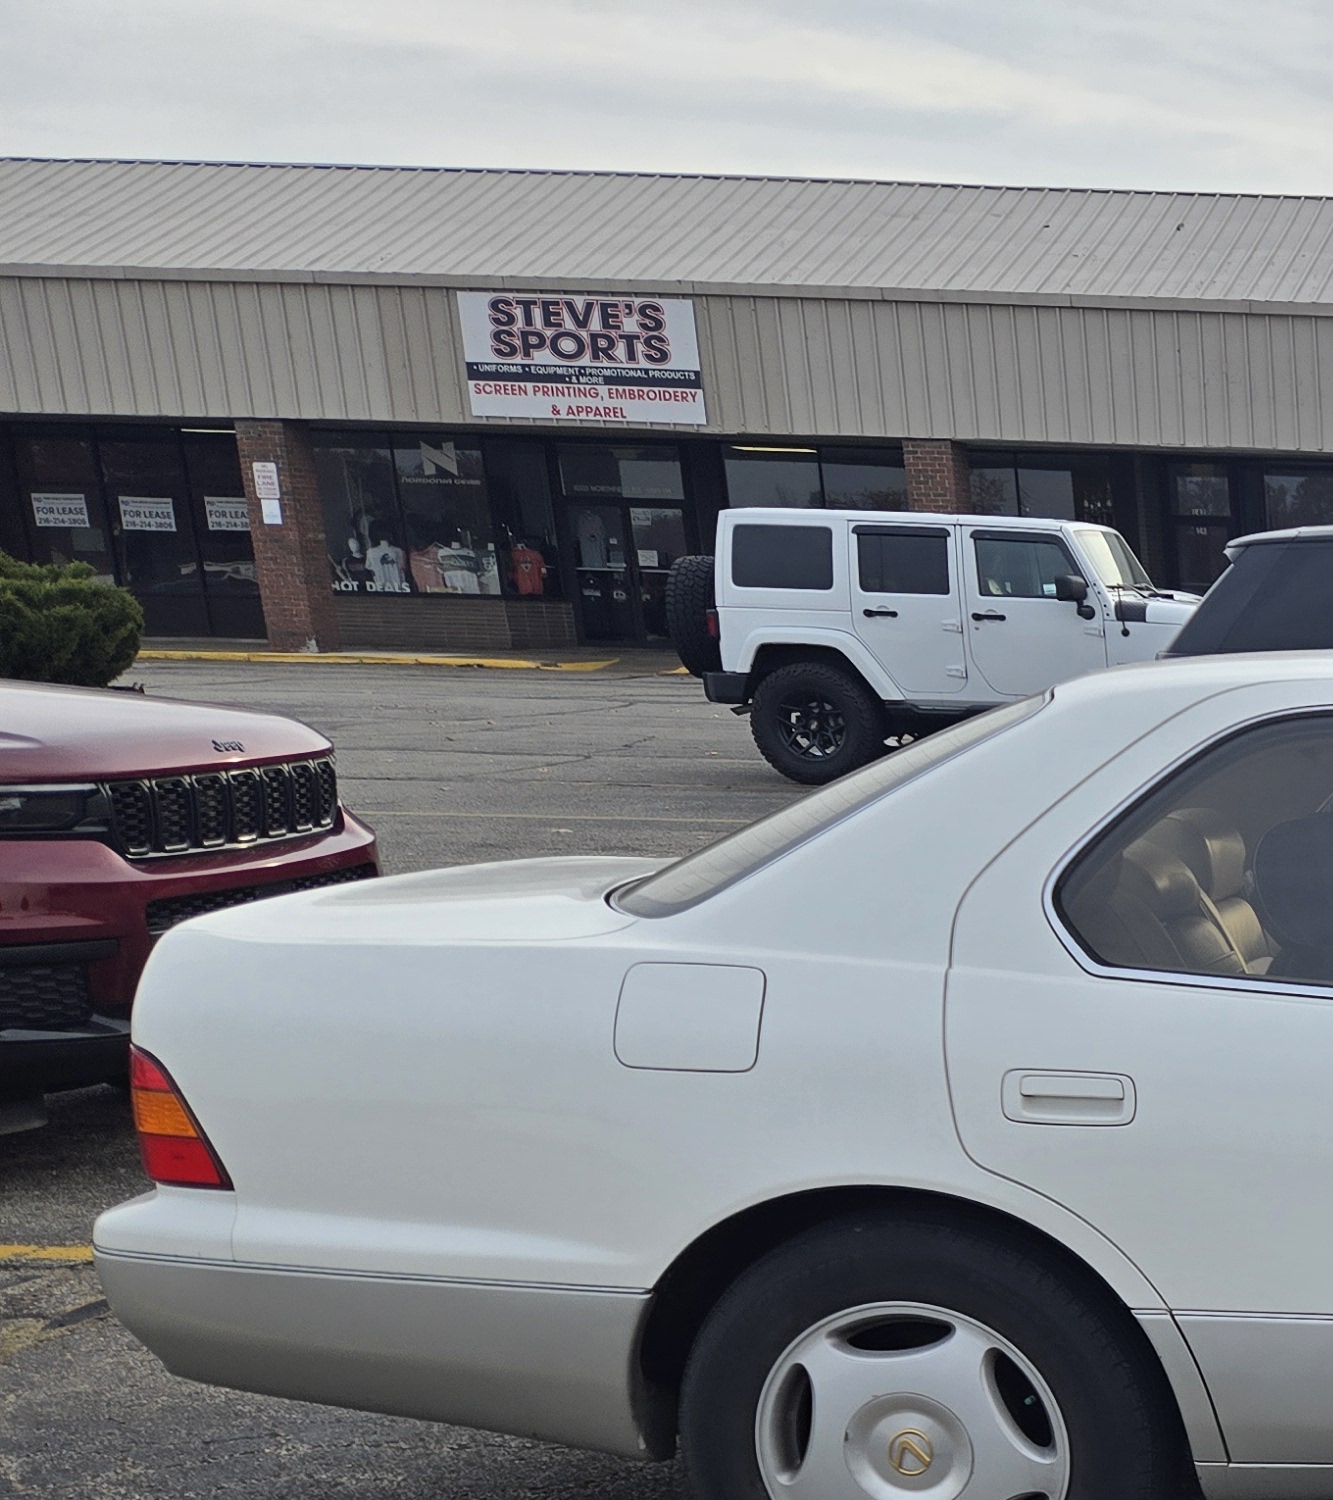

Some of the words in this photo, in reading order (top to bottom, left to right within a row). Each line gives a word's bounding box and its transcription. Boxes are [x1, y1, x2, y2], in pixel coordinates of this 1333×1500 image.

[488, 296, 666, 333] STEVE'S
[489, 328, 671, 366] SPORTS
[478, 364, 523, 374] UNIFORMS
[530, 365, 579, 376] EQUIPMENT
[585, 367, 648, 379] PROMOTIONAL
[648, 370, 696, 380] PRODUCTS
[579, 376, 605, 385] MORE
[474, 383, 529, 397] SCREEN
[532, 384, 604, 401] PRINTING,
[608, 386, 698, 403] EMBROIDERY
[551, 404, 562, 416] &
[566, 405, 627, 419] APPAREL
[36, 506, 55, 515] FOR
[56, 507, 85, 516] LEASE
[123, 509, 142, 518] FOR
[143, 510, 172, 519] LEASE
[209, 510, 228, 518] FOR
[228, 510, 249, 519] LEA
[125, 520, 173, 529] 216-214-3806
[211, 520, 249, 529] 216-214-38
[366, 581, 411, 593] DEALS
[211, 739, 246, 753] Jeep
